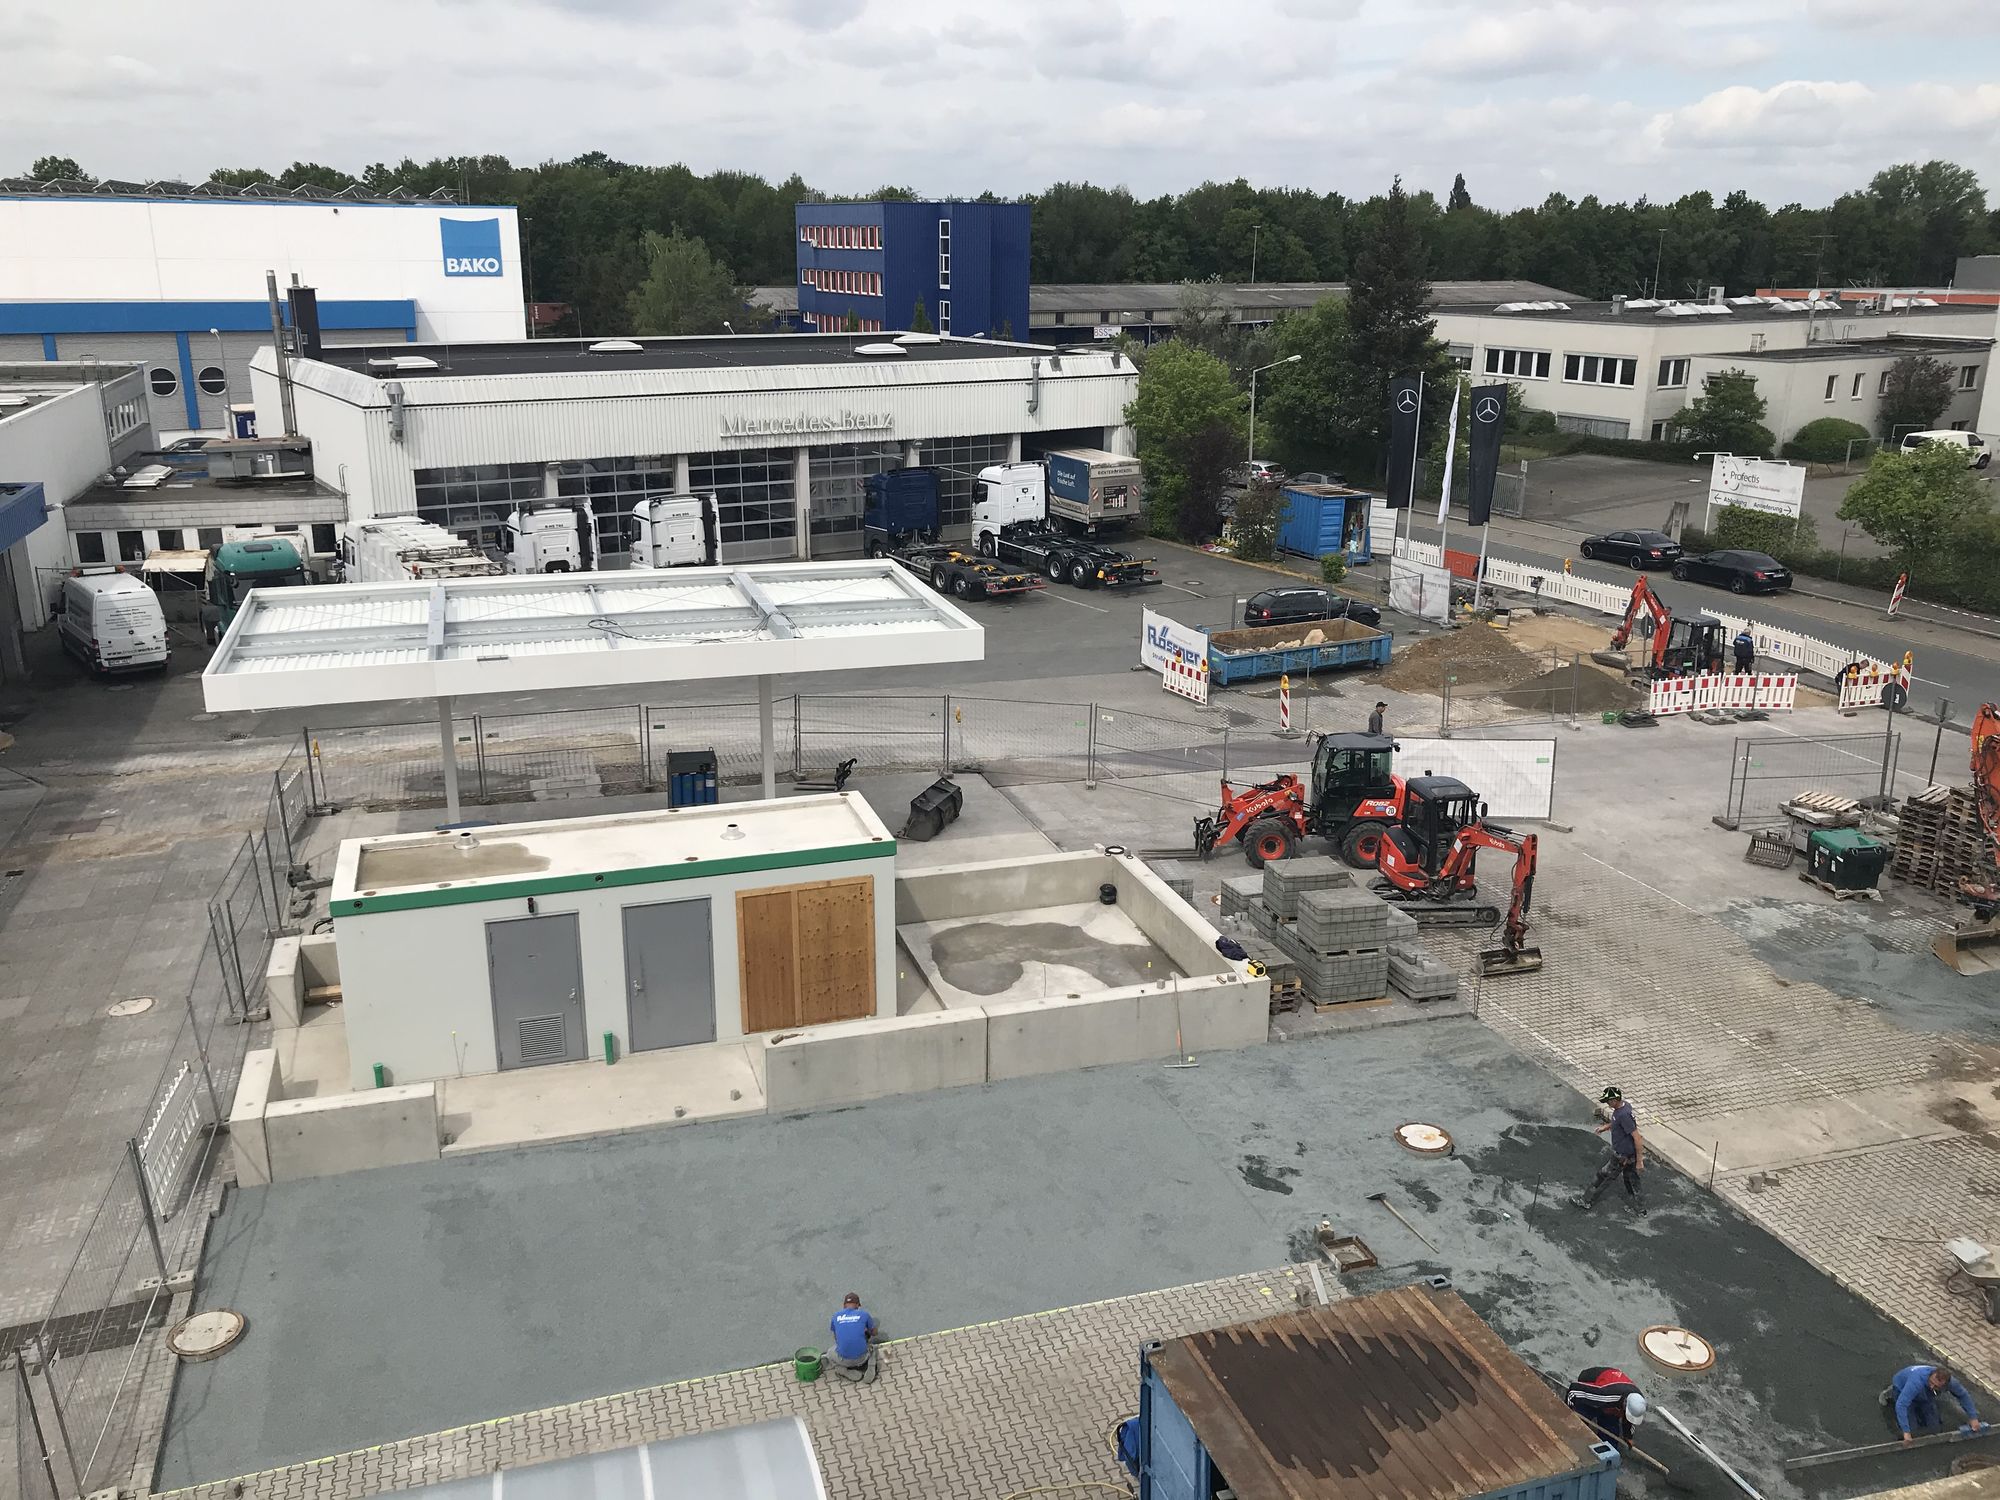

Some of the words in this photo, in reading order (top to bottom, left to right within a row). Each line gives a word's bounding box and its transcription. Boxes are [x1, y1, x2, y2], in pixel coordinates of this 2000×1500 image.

[446, 257, 500, 273] BÄKO
[720, 409, 895, 437] Mercedes-Benz
[1730, 471, 1760, 484] Profectis
[1753, 502, 1784, 514] Anlieferung
[1246, 797, 1274, 814] Kubota
[1388, 807, 1395, 815] 20
